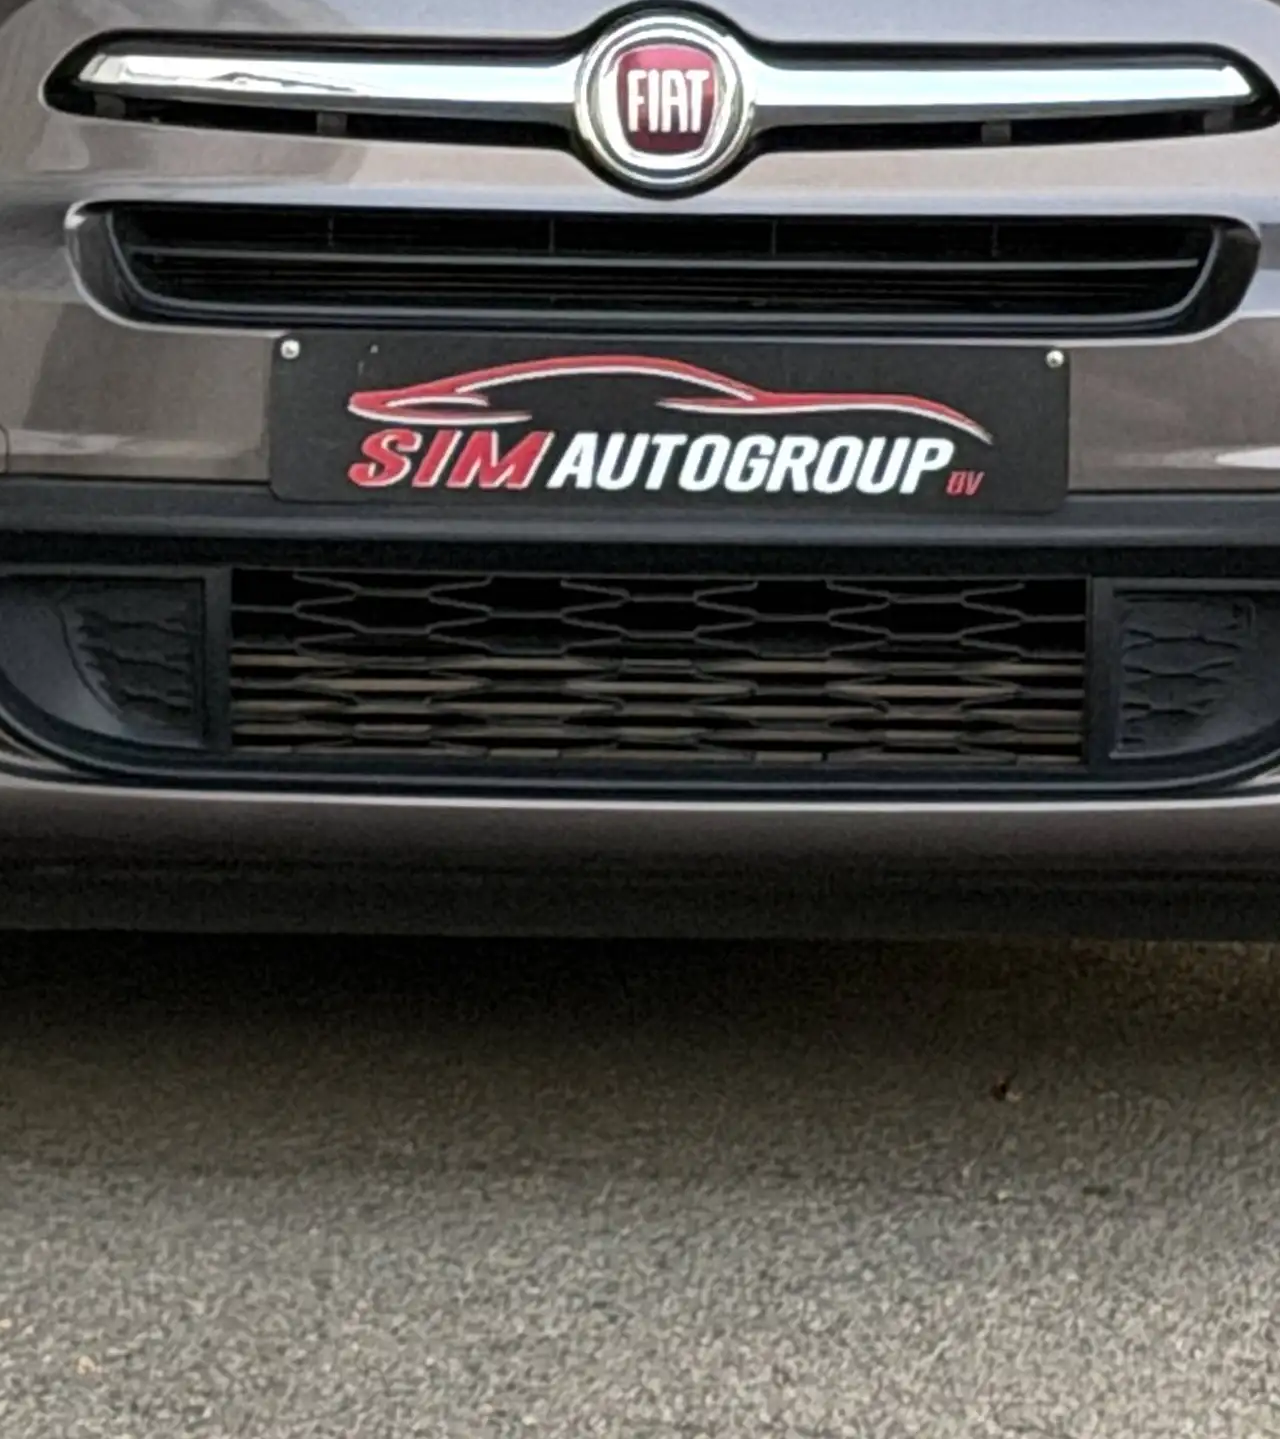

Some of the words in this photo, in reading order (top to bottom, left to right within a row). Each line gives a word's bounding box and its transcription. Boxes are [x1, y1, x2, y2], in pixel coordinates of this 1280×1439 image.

[627, 68, 710, 133] FIAT
[348, 428, 554, 490] SIM
[547, 431, 954, 494] AUTOGROUP
[946, 470, 984, 496] BV
